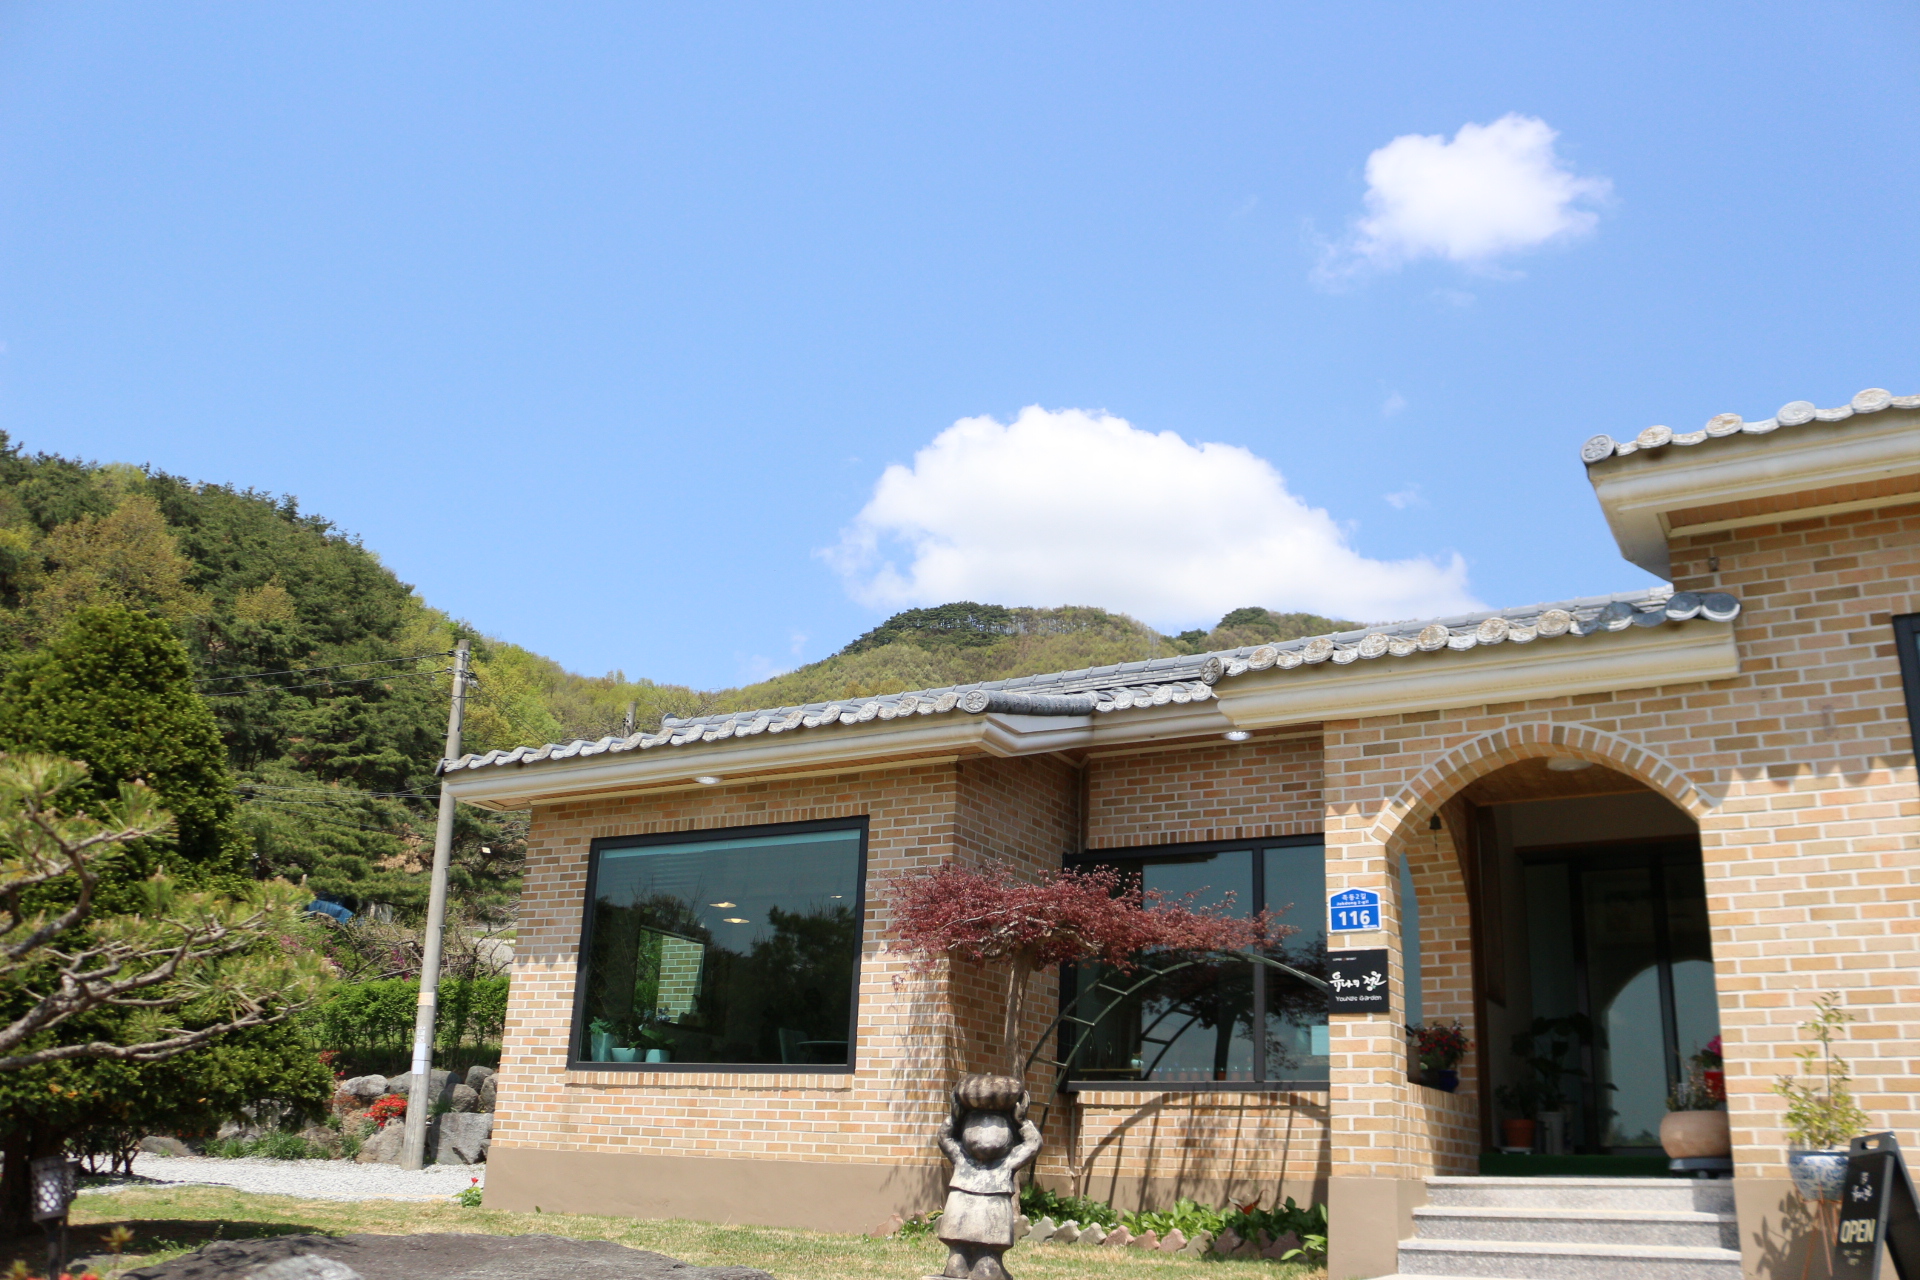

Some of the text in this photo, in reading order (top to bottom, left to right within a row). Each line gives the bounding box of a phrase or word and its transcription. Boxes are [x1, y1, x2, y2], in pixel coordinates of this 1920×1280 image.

[1338, 910, 1370, 925] 116
[1361, 970, 1387, 991] 정원
[1840, 1218, 1876, 1244] OPEN
